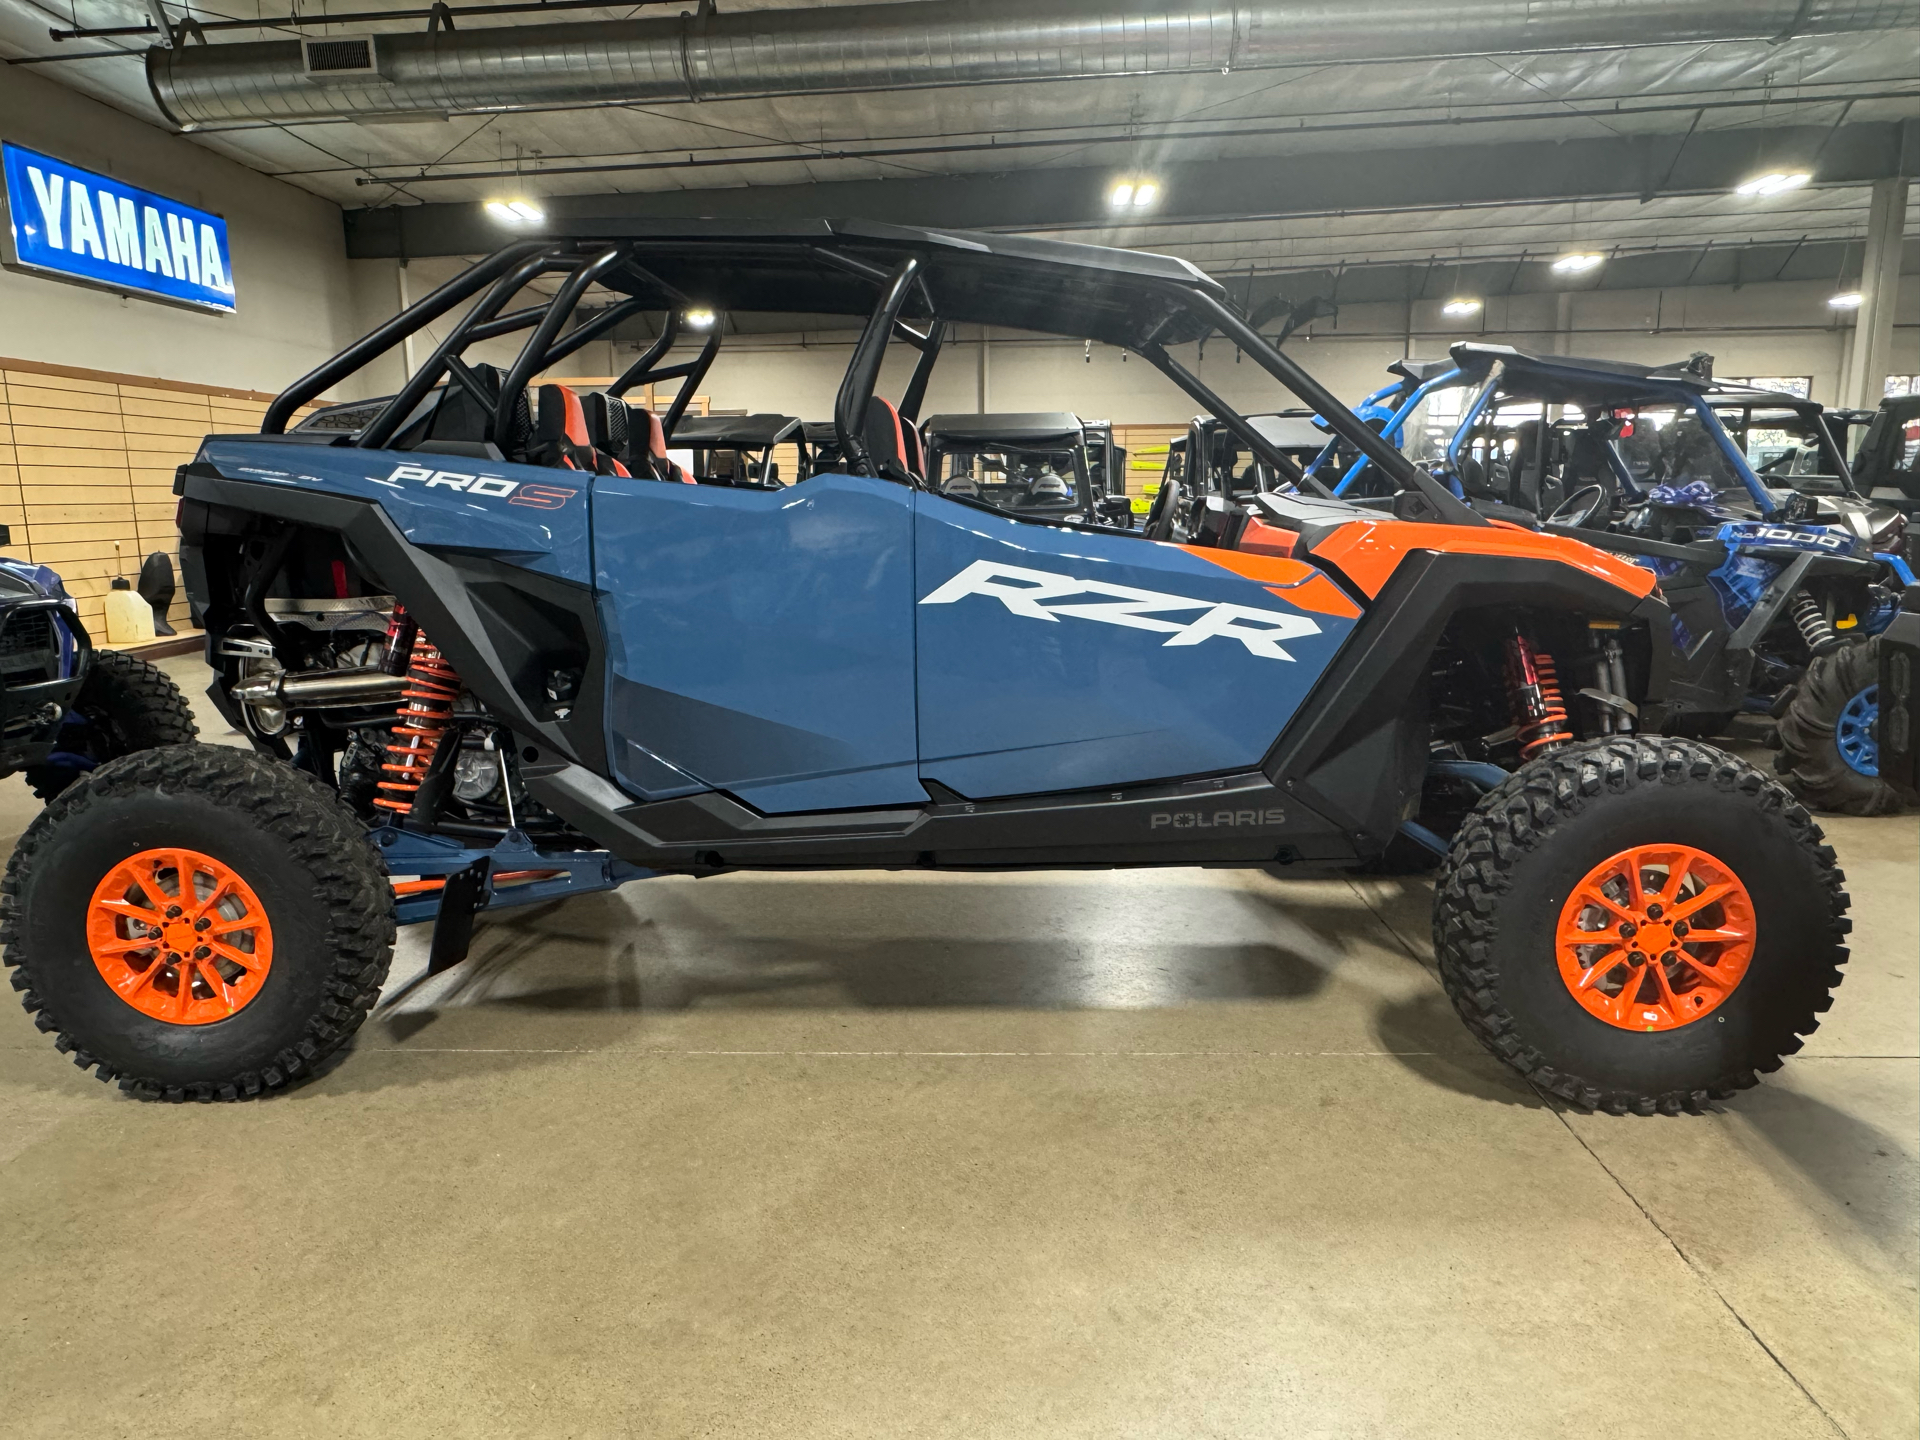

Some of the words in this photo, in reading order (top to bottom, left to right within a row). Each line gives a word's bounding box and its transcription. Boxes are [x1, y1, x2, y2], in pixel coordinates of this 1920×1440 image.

[27, 166, 228, 287] YAMAHA
[387, 465, 520, 498] PRO
[508, 484, 579, 510] S
[1756, 527, 1842, 548] 1000
[918, 559, 1323, 662] RZR
[1151, 808, 1286, 829] POLARIS
